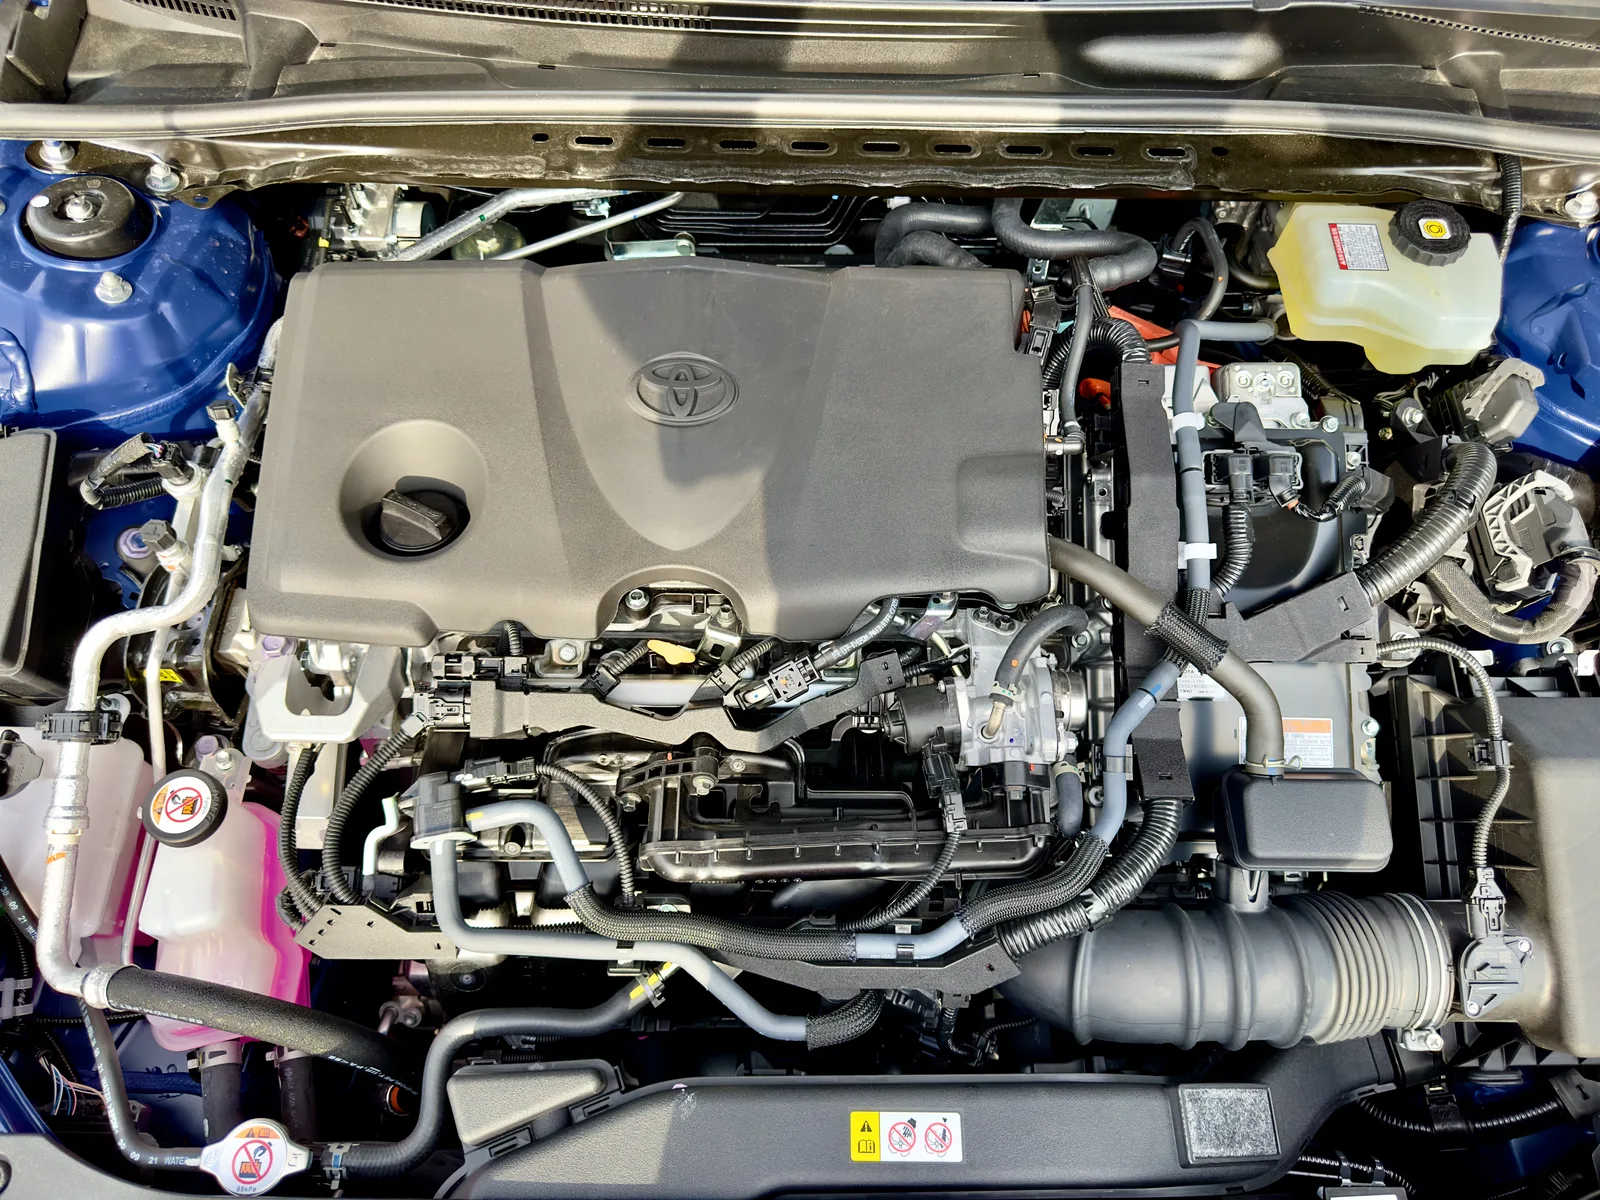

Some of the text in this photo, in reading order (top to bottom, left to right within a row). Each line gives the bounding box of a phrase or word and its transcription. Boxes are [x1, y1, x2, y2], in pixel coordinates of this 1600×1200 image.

[0, 886, 10, 896] 30
[9, 901, 19, 911] 09
[18, 915, 28, 924] 21
[100, 1076, 112, 1103] WATER
[118, 1138, 127, 1150] 30
[130, 1151, 140, 1161] 09
[148, 1156, 159, 1165] 21
[236, 1185, 257, 1193] 88kPa
